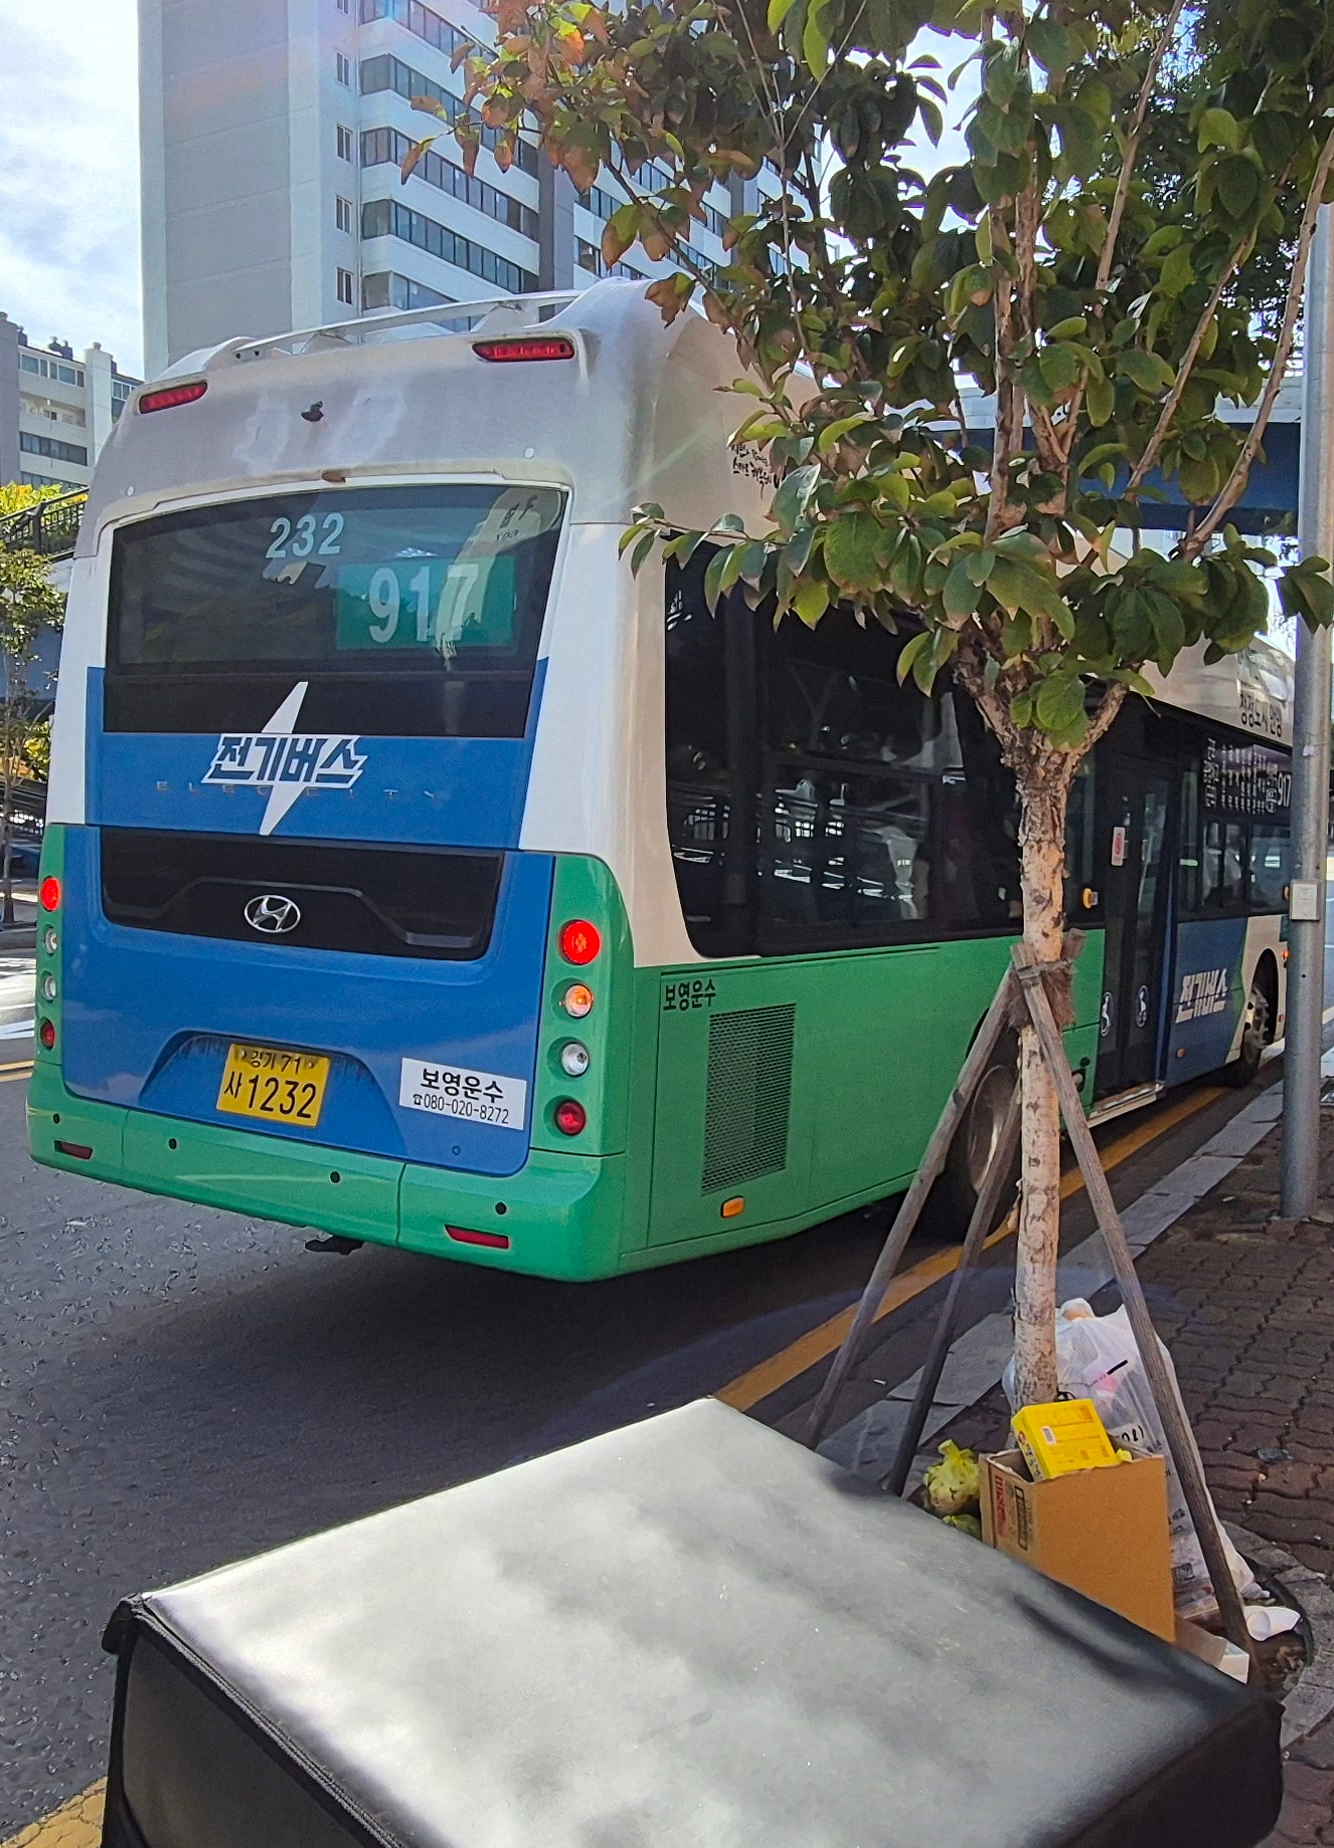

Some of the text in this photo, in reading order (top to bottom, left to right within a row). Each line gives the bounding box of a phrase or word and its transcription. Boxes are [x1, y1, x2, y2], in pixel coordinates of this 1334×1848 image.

[266, 511, 345, 559] 232
[368, 563, 479, 644] 917
[205, 735, 363, 786] 전기버스
[1277, 771, 1292, 808] 917
[663, 978, 716, 1011] 보영운수
[1174, 967, 1229, 1025] 전기버스
[250, 1050, 302, 1075] 경기 71
[420, 1067, 504, 1104] 보영운수
[423, 1093, 509, 1125] 080-020-8272
